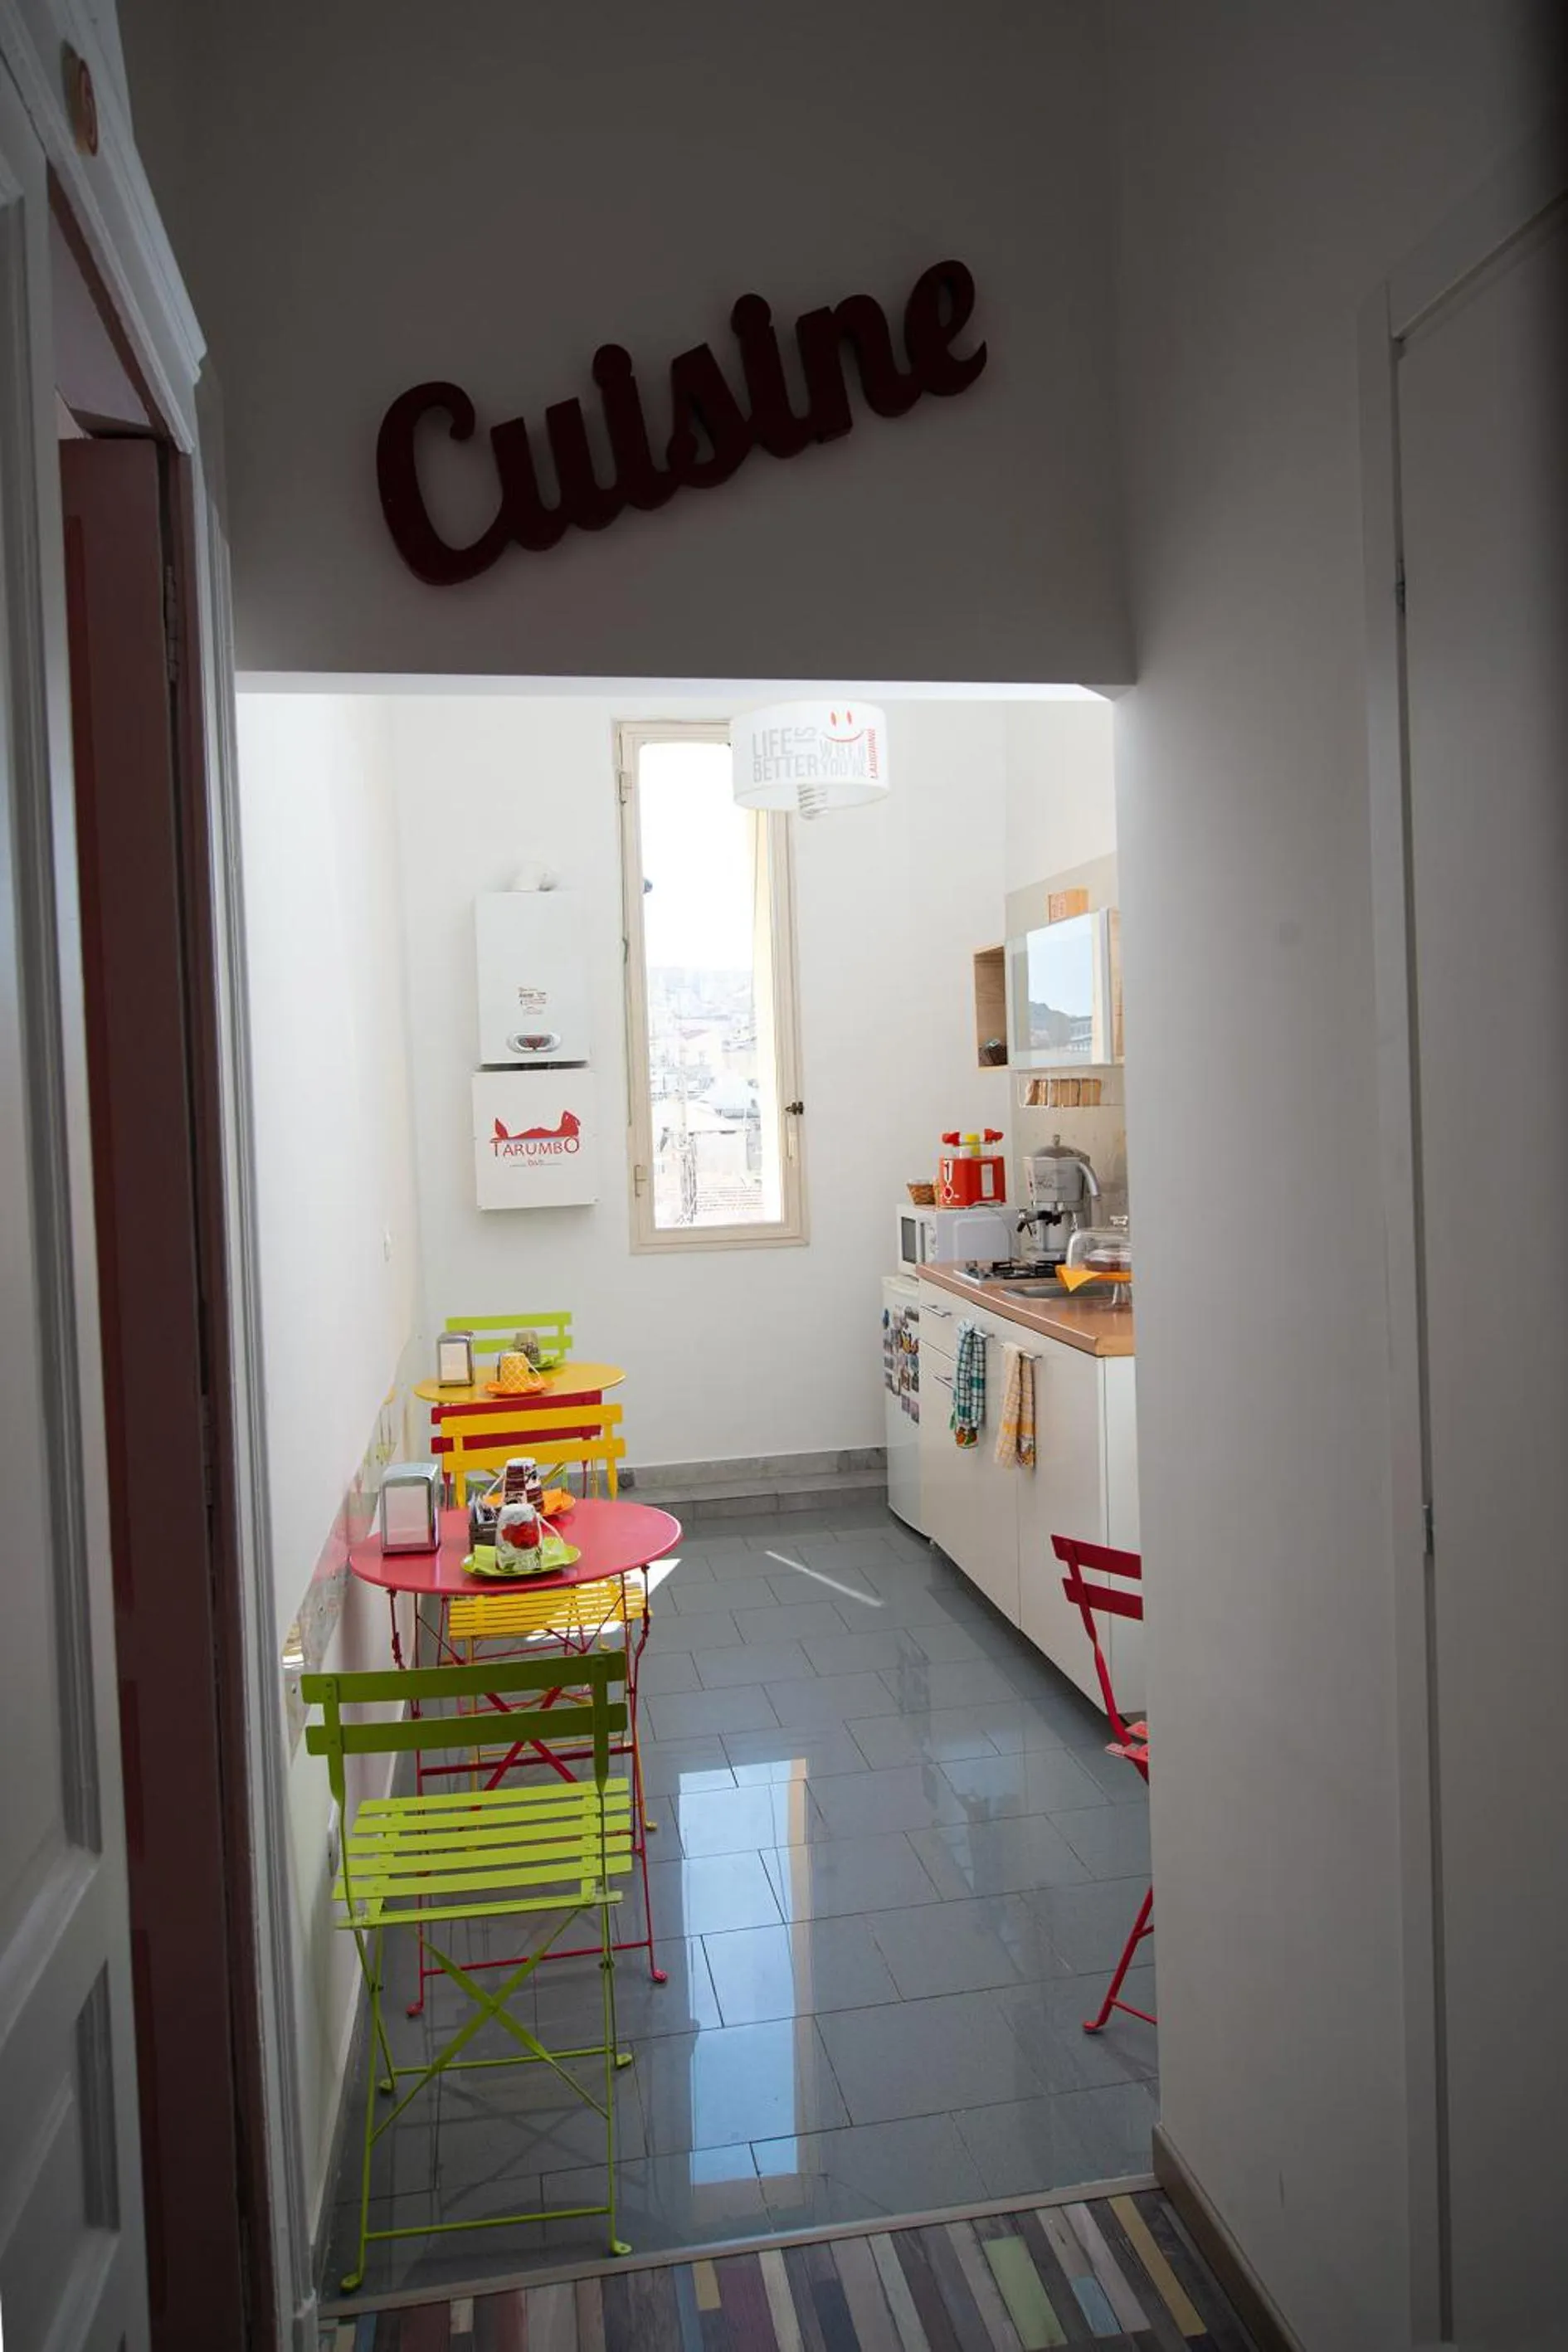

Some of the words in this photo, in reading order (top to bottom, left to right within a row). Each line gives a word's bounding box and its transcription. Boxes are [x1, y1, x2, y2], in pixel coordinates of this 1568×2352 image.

[376, 259, 987, 587] Cuisine
[752, 727, 793, 758] LIFE
[752, 753, 818, 783] BETTER
[489, 1137, 579, 1157] TARUMBO
